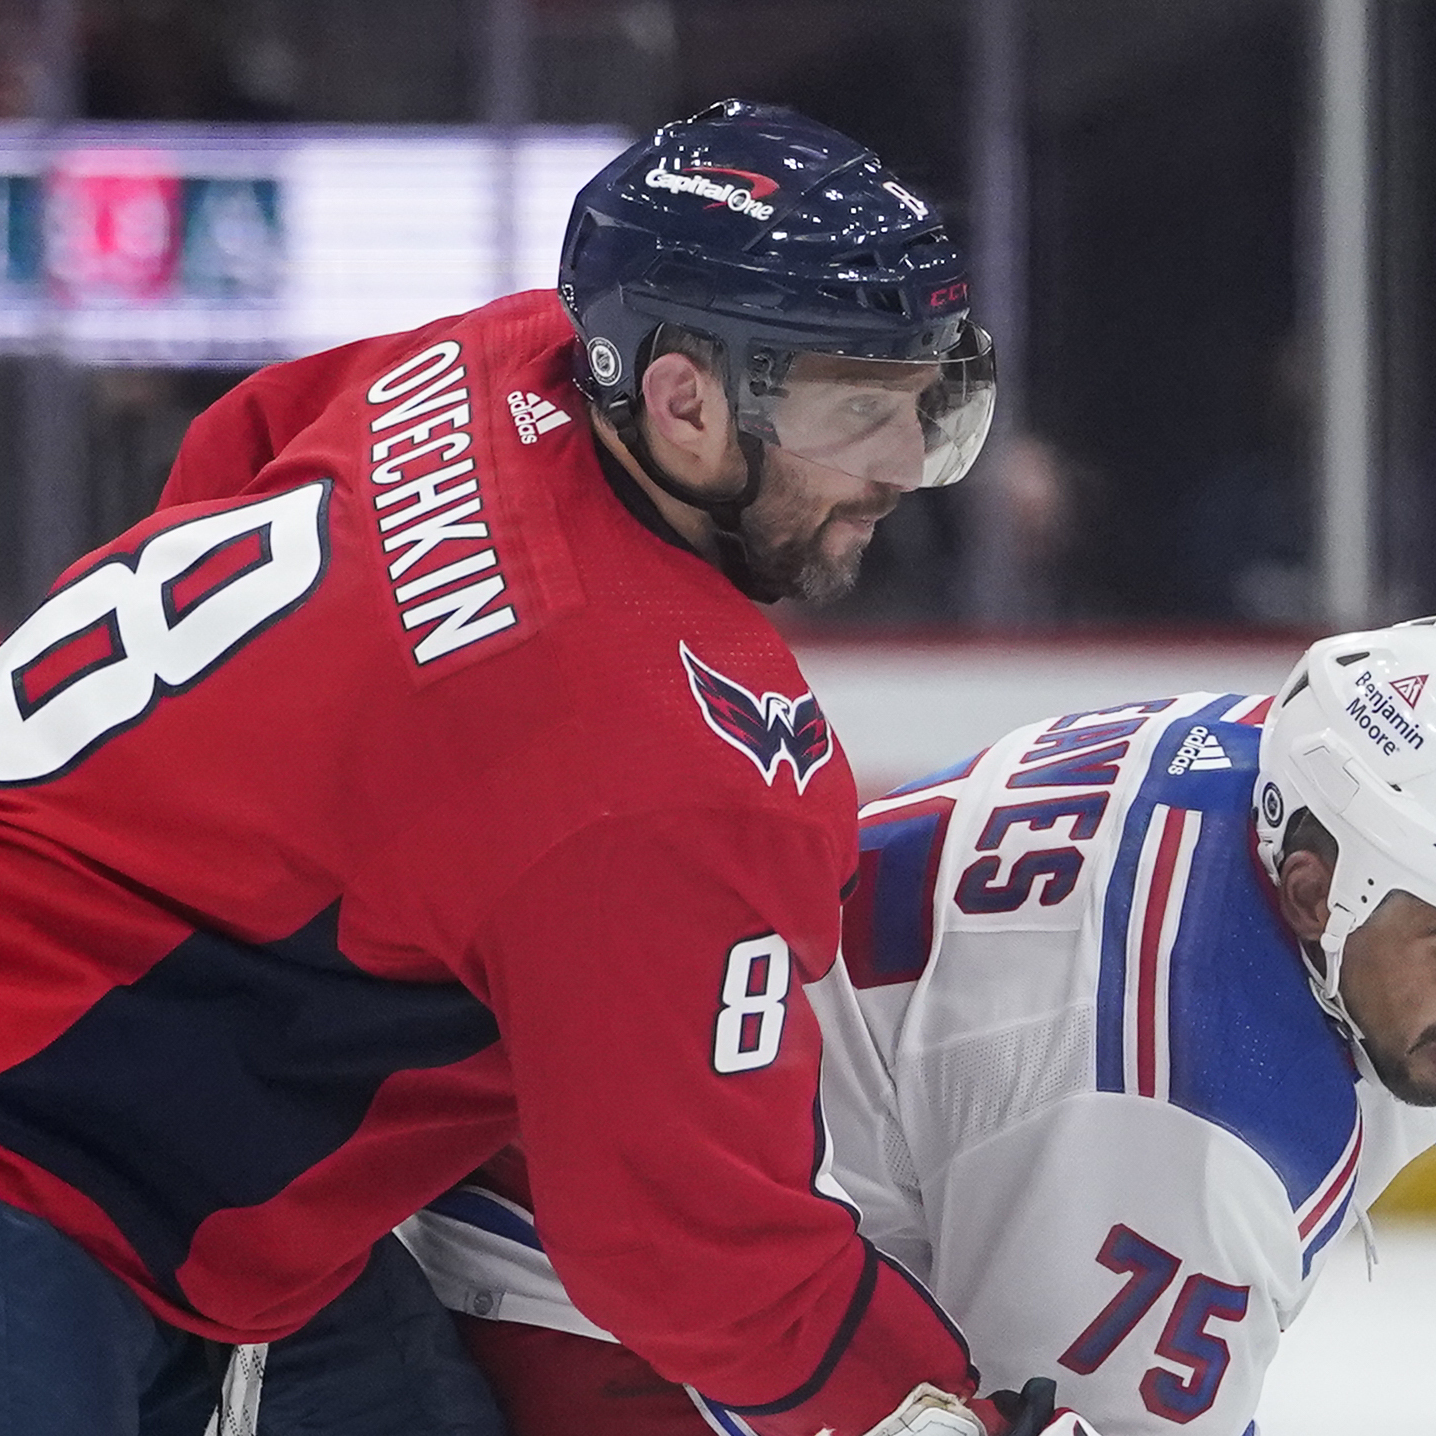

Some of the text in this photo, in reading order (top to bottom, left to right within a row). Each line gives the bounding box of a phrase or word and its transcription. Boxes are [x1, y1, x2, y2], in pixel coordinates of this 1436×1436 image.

[883, 180, 929, 219] 8
[930, 283, 967, 306] CC
[507, 391, 538, 444] adidas
[366, 339, 518, 666] OVECHKIN
[1345, 697, 1396, 756] Moore
[1355, 671, 1425, 750] Benjamin
[1167, 726, 1209, 775] adidas
[953, 698, 1178, 915] EAVES
[712, 929, 791, 1075] 8
[1057, 1223, 1251, 1425] 75
